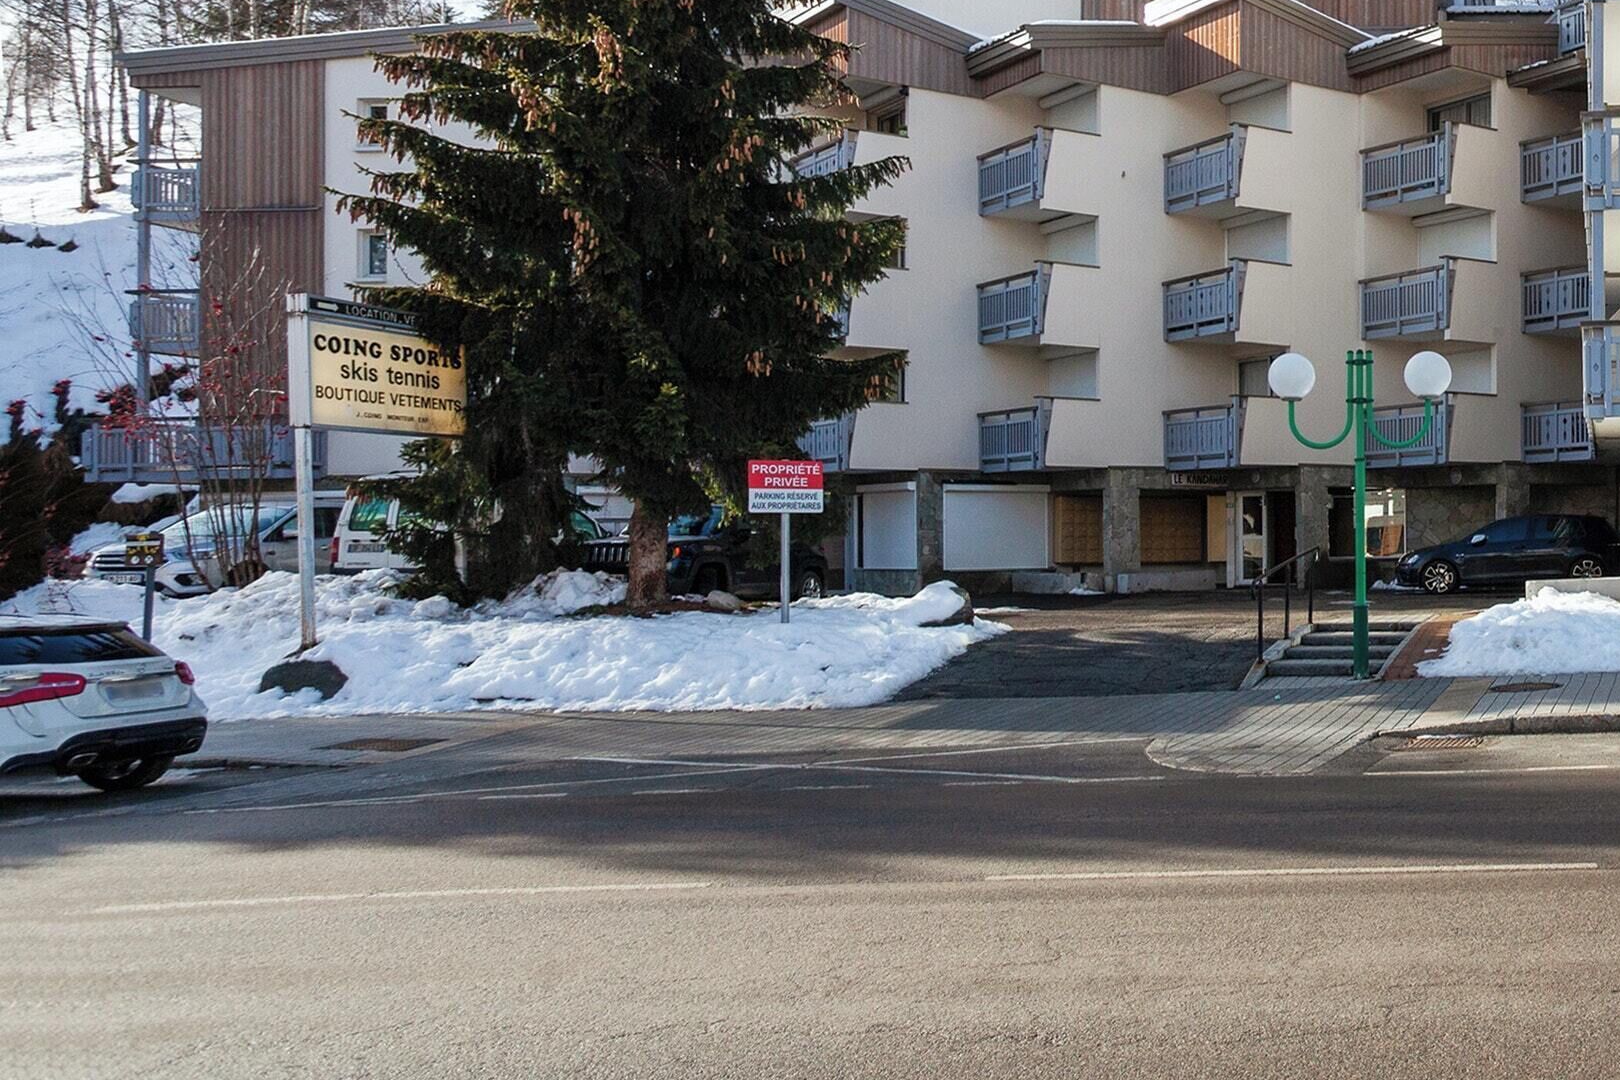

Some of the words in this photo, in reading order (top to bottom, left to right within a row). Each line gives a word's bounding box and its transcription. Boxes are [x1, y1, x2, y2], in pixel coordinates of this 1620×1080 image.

[313, 333, 383, 359] COING
[390, 344, 462, 369] SPORTS
[340, 360, 378, 383] skis
[386, 366, 441, 390] tennis
[315, 384, 386, 405] BOUTIQUE
[389, 393, 463, 413] VETEMENTS
[751, 463, 821, 475] PROPRIÉTÉ
[764, 475, 809, 487] PRIVÉE
[754, 492, 786, 500] PARKING
[751, 502, 766, 510] AUX
